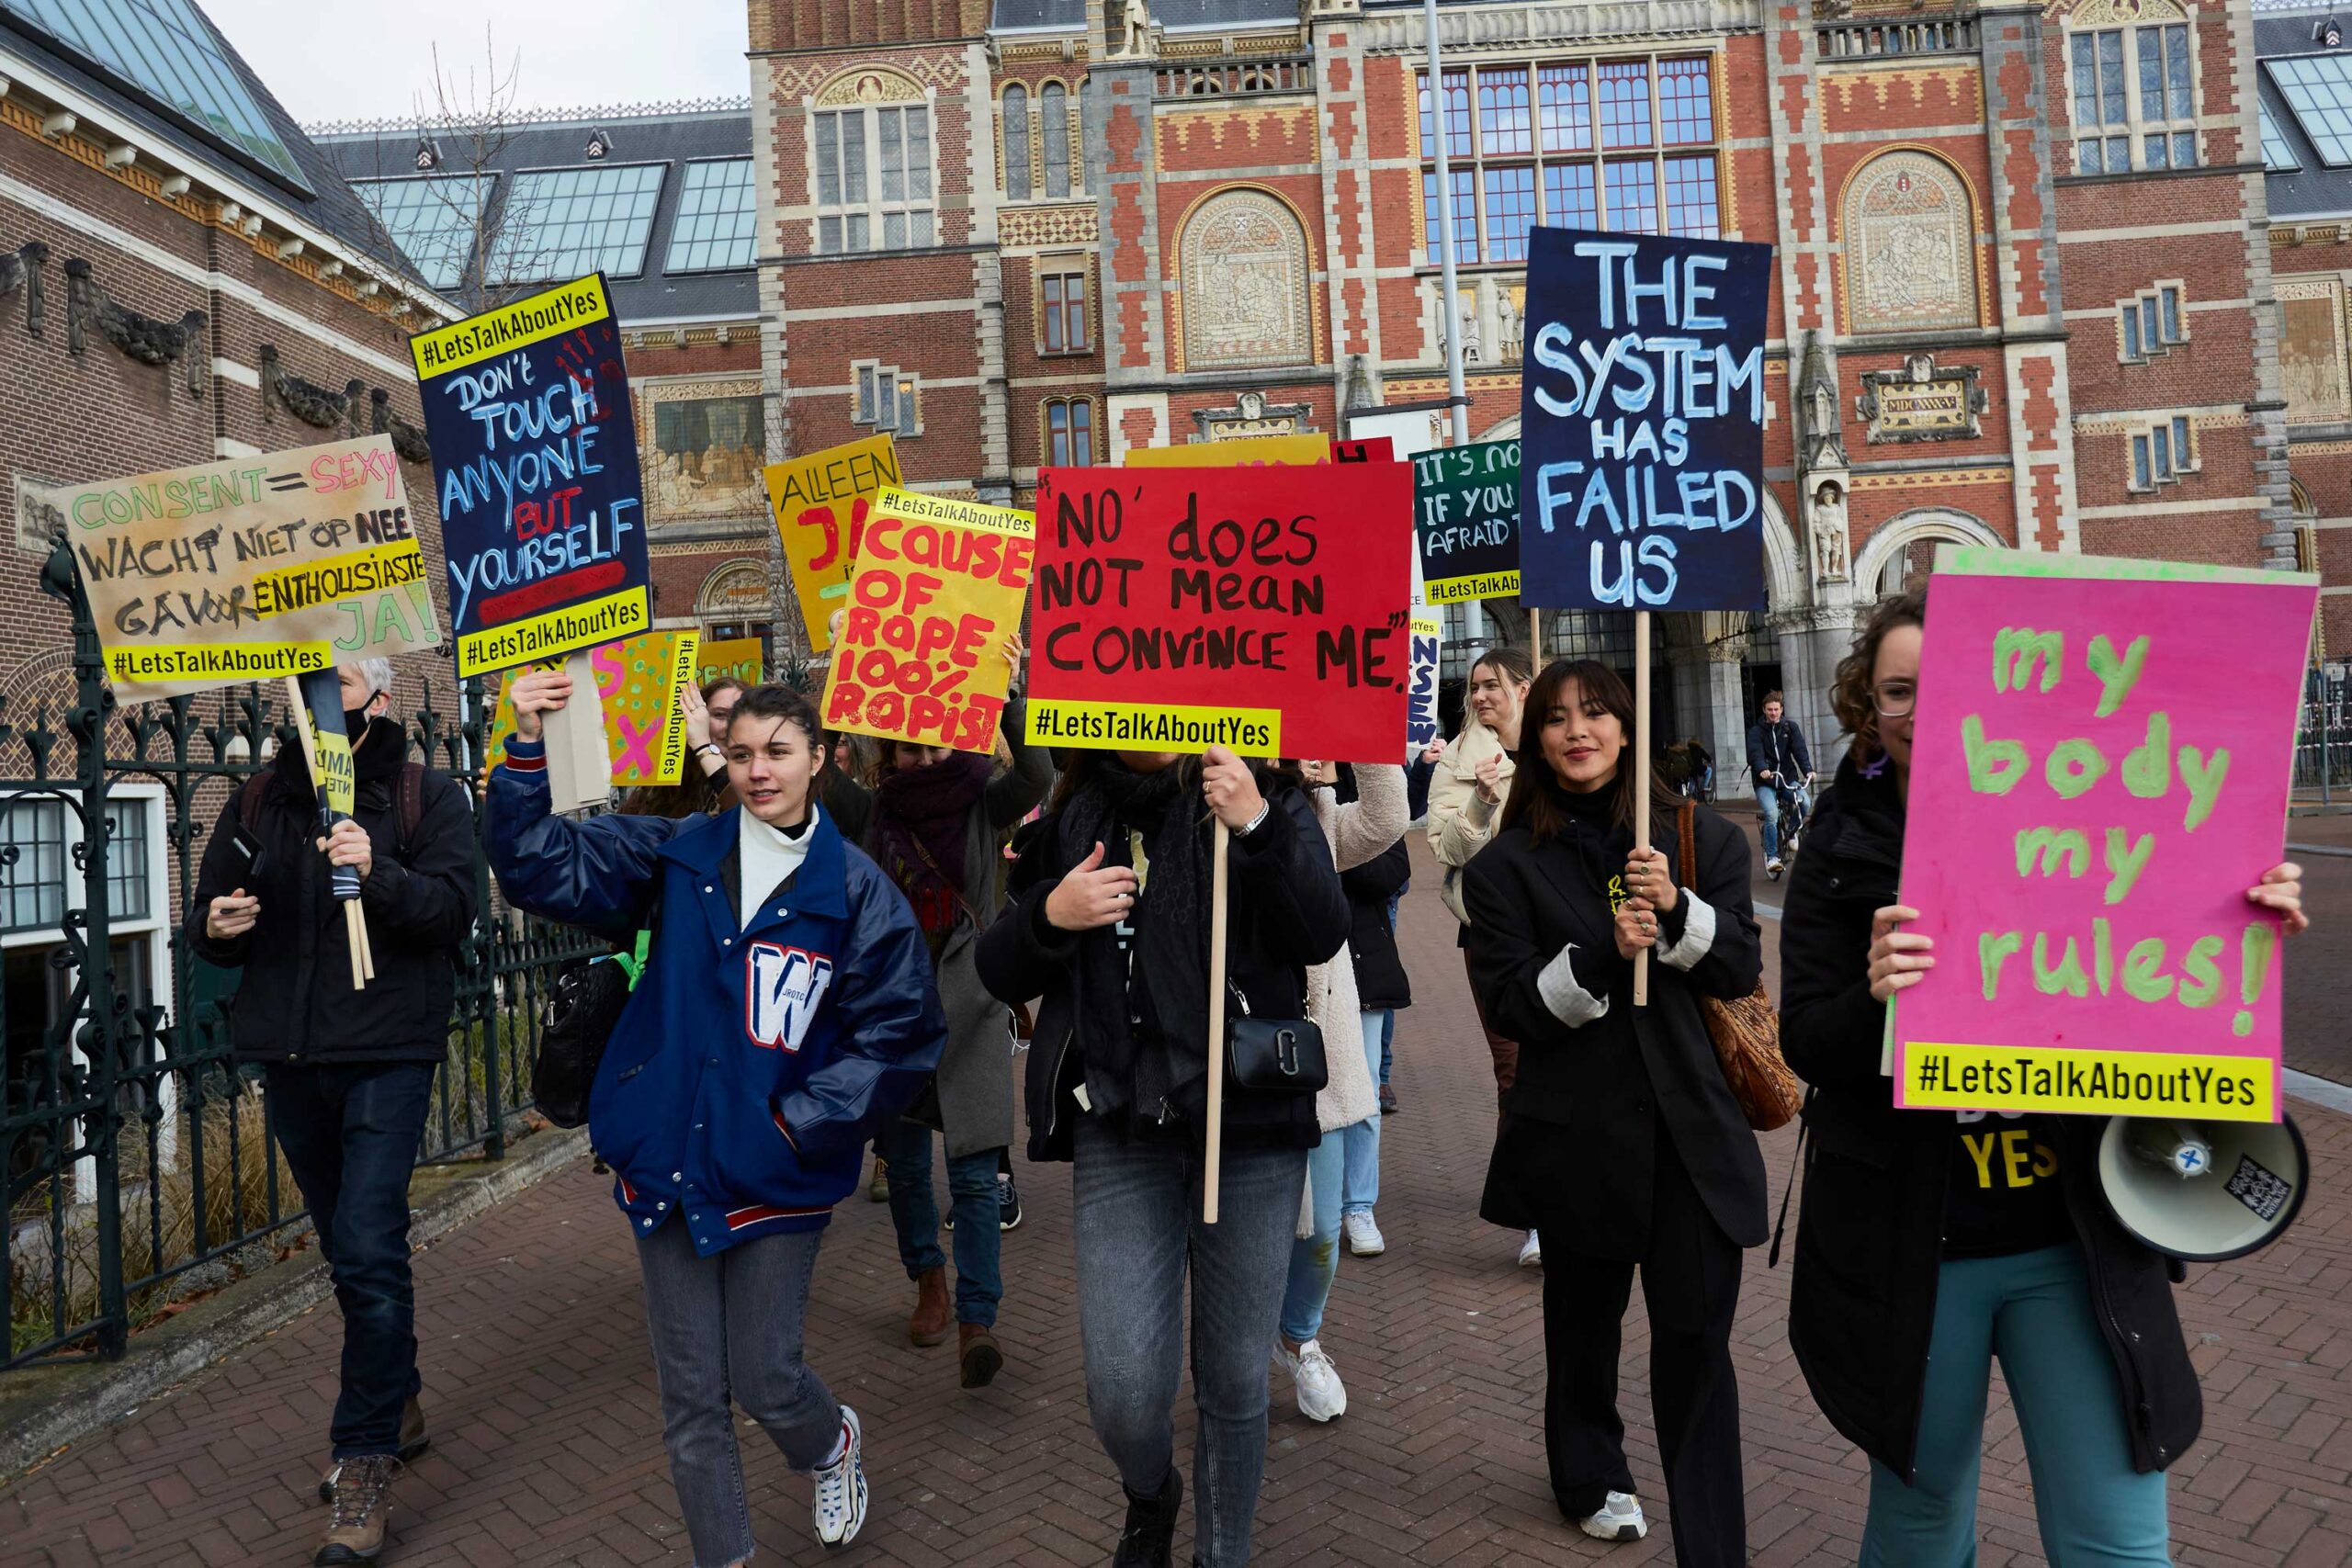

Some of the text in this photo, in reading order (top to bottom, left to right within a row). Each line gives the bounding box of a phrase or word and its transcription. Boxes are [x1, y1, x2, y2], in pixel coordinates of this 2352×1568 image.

[1574, 242, 1727, 329] THE
[424, 290, 597, 367] #LetsTalkAboutYes
[1533, 321, 1764, 424] SYSTEM
[470, 368, 599, 451] TOUCH
[1590, 417, 1689, 467] HAS
[442, 426, 605, 533] ANYONE
[497, 449, 555, 487] IT'S
[781, 446, 899, 512] ALLEEN
[1536, 461, 1757, 534] FAILED
[514, 487, 582, 541] BUT
[883, 492, 1031, 532] #LetsTalkAboutYes
[1168, 491, 1317, 567] does
[1424, 483, 1515, 525] IF YOU
[1426, 519, 1510, 557] AFRAID
[79, 506, 413, 581] WACHT NIET OP NEE
[449, 498, 639, 630] YOURSELF
[334, 582, 439, 652] JA!
[855, 570, 943, 615] OF
[1040, 558, 1144, 611] NOT
[1431, 575, 1520, 600] #LetsTalkAb
[113, 647, 323, 675] #LetsTalkAboutYes
[467, 602, 639, 667] #LetsTalkAboutYes
[837, 649, 968, 697] 100%
[1992, 626, 2151, 716] my
[1036, 709, 1269, 746] #LetsTalkAboutYes
[1961, 712, 2230, 833] body
[2015, 827, 2154, 905] my
[747, 942, 832, 1051] W
[1979, 918, 2275, 1036] rules!
[1918, 1055, 2255, 1106] #LetsTalkAboutYes
